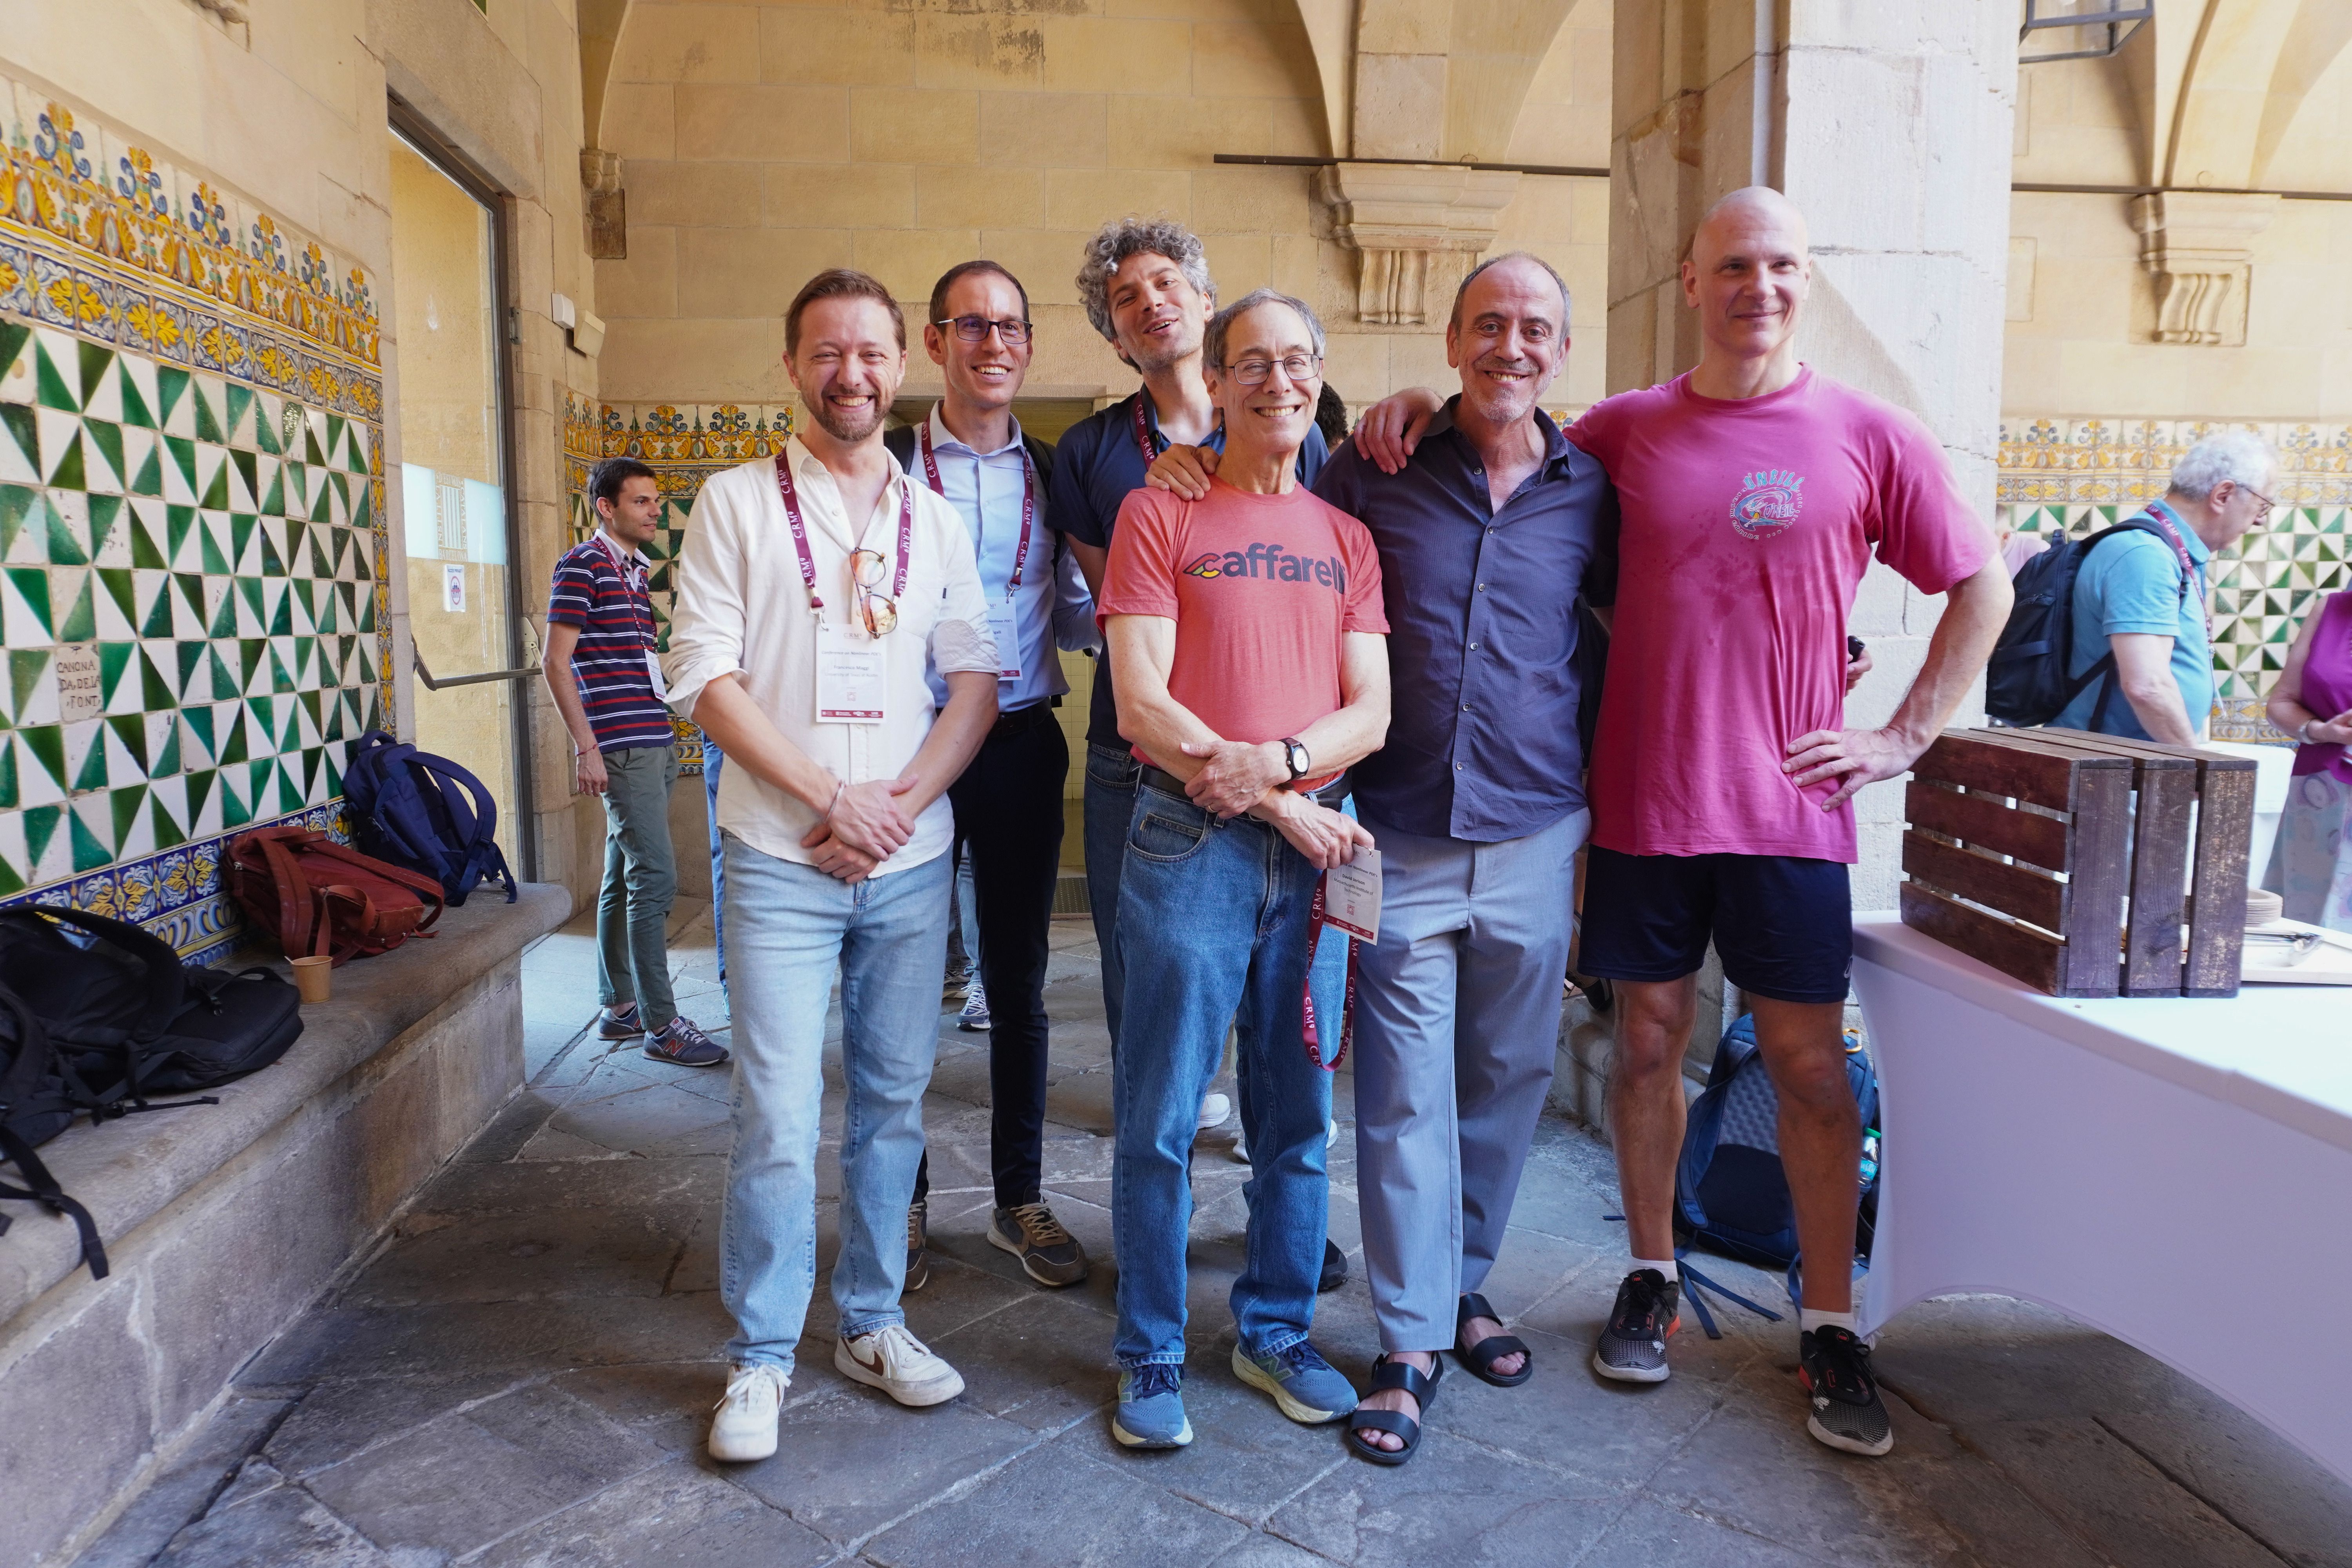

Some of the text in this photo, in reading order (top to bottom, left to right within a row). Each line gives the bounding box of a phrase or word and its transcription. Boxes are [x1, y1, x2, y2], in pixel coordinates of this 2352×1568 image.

[1183, 542, 1346, 595] Caffarell
[1353, 865, 1368, 874] Nonlinear
[1334, 878, 1356, 889] Massachusetts
[1344, 887, 1361, 897] Technology
